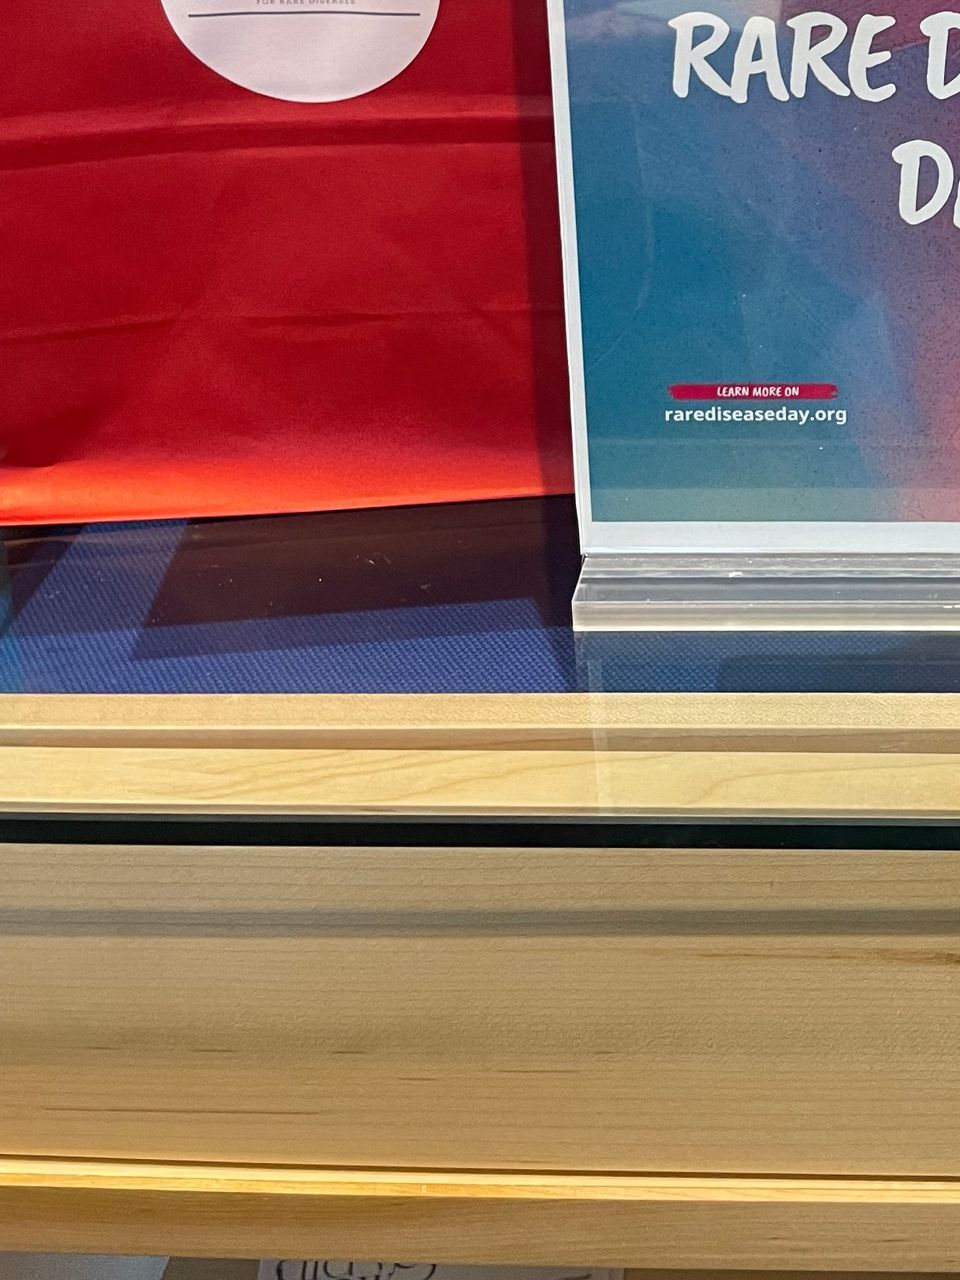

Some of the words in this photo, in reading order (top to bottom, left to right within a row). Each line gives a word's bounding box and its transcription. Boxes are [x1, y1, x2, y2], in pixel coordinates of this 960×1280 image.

[667, 10, 897, 104] RARE
[716, 386, 750, 397] LEARN
[752, 386, 782, 397] MORE
[784, 386, 800, 397] ON
[665, 406, 847, 425] rarediseaseday.org
